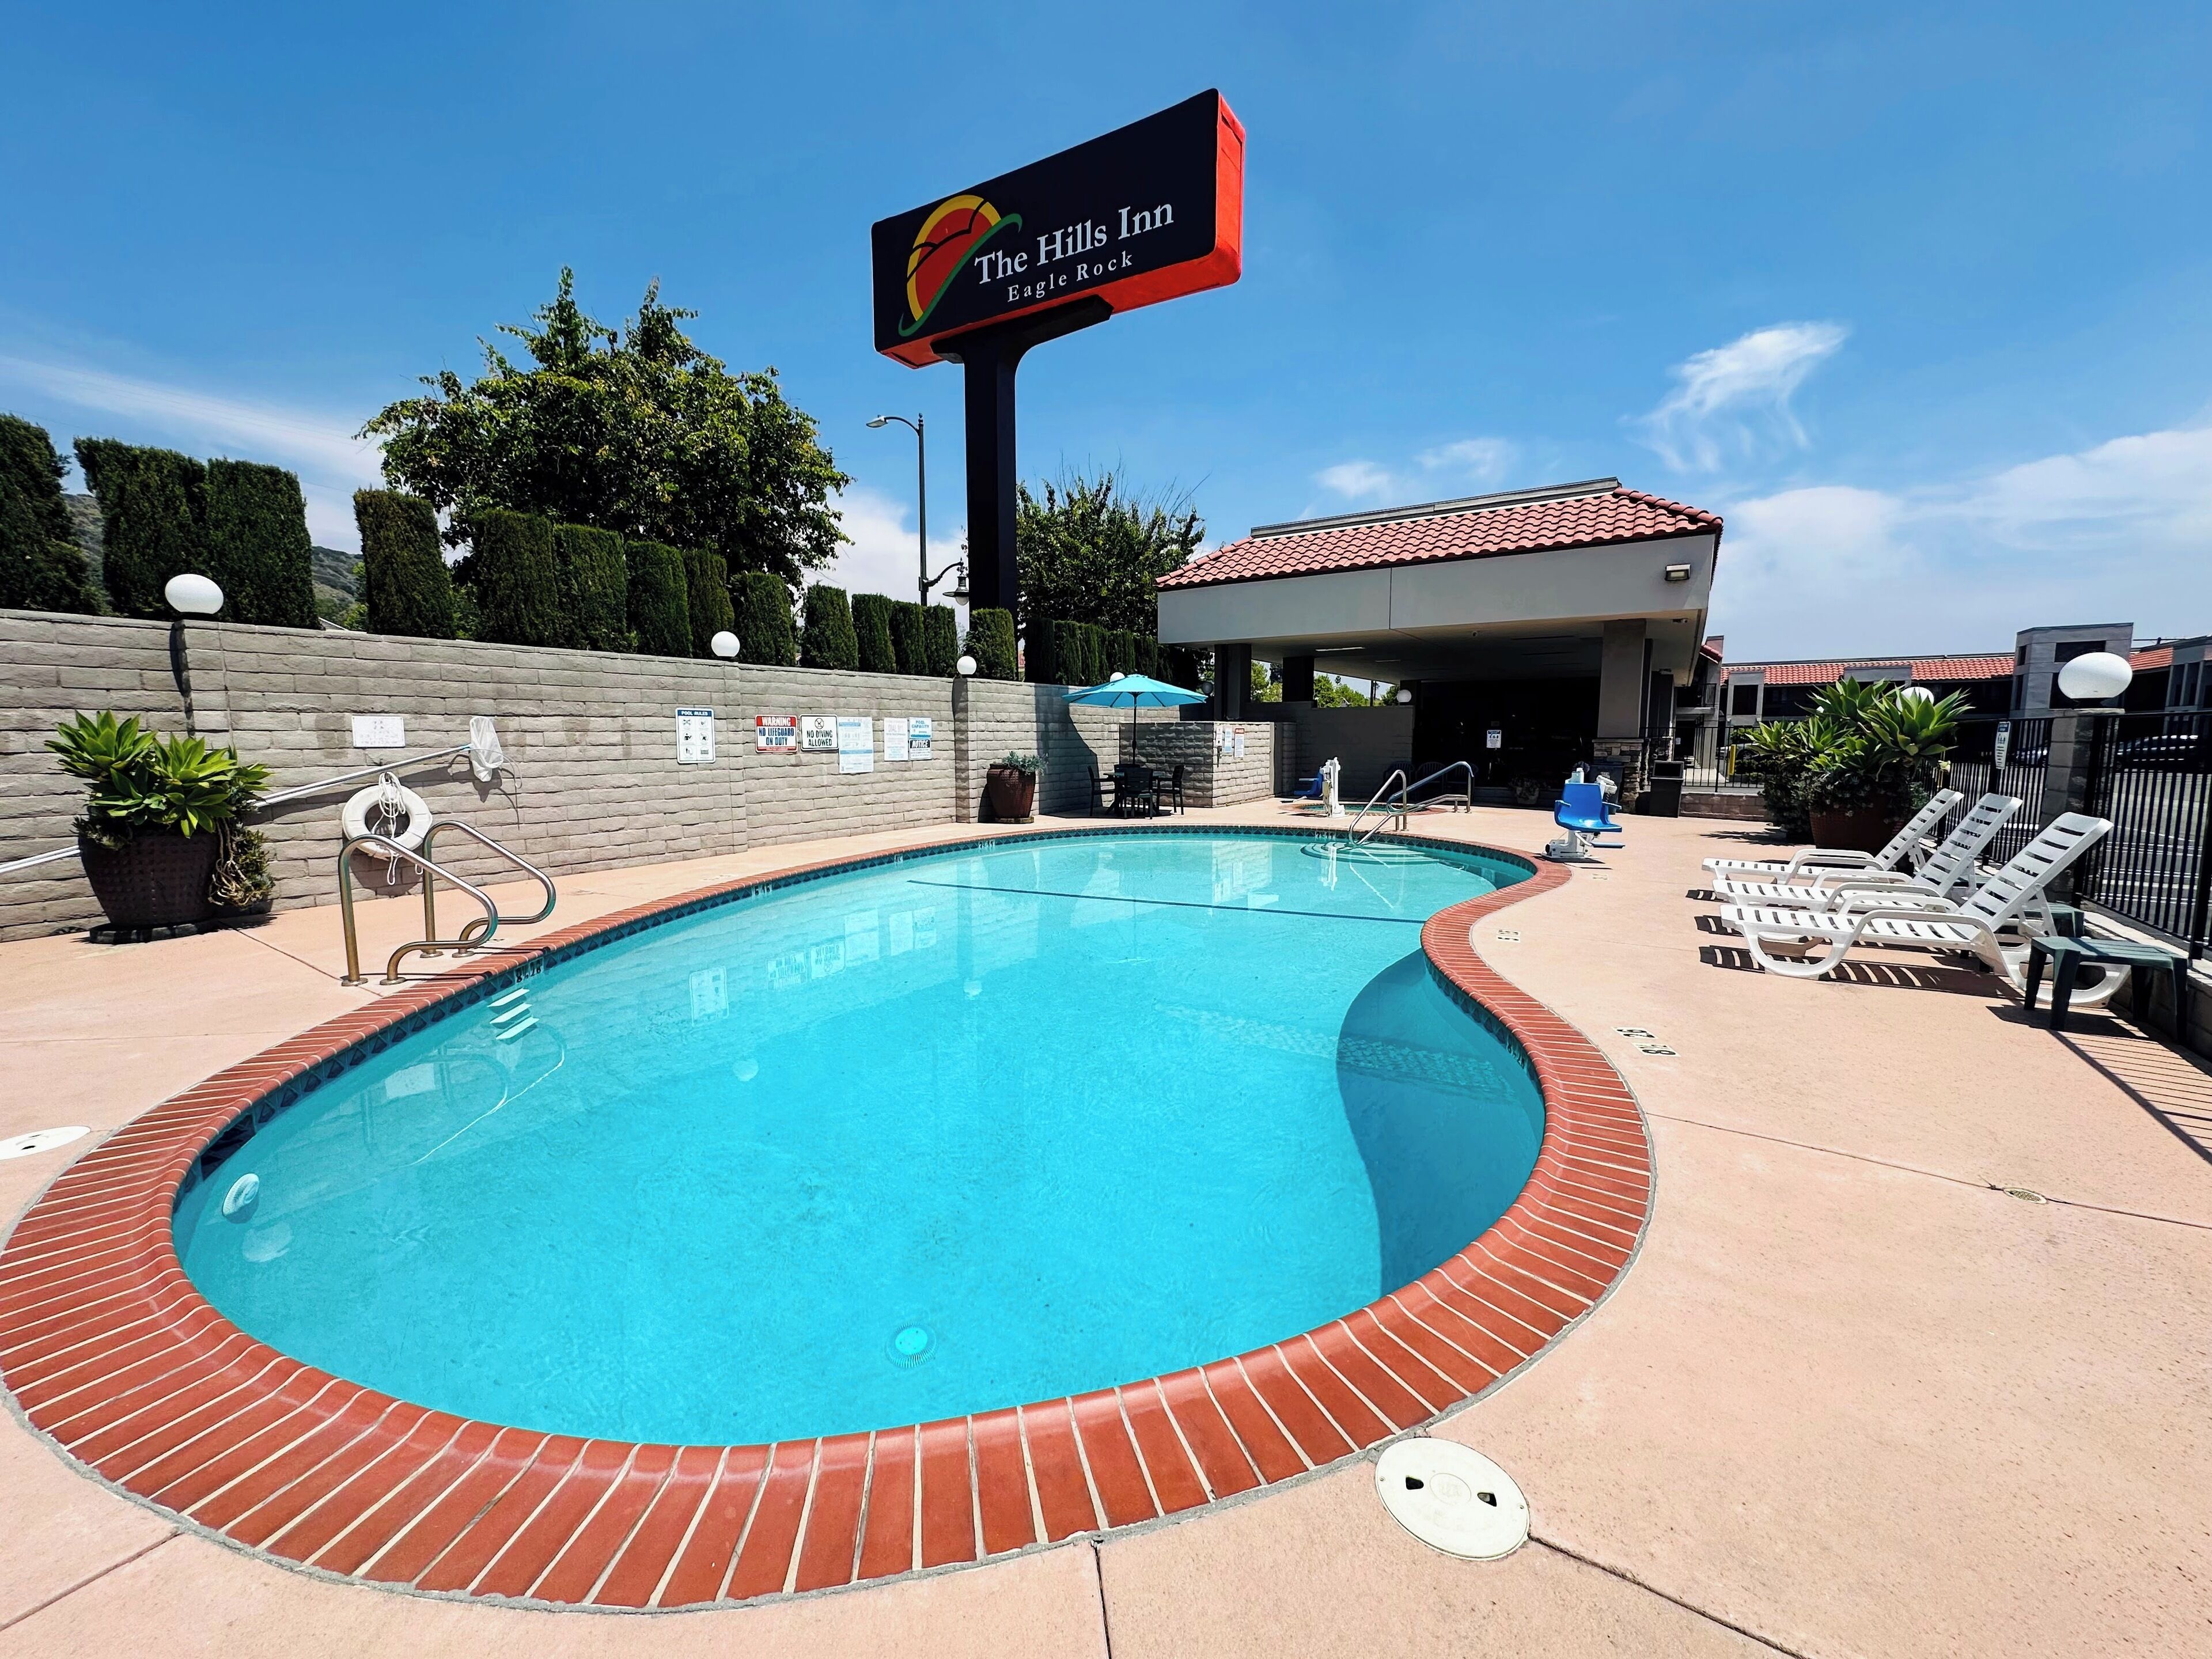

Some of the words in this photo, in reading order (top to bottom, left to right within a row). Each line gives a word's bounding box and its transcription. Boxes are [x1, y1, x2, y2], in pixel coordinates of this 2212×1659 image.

[974, 249, 1028, 284] The
[1037, 219, 1107, 266] Hills
[1118, 203, 1174, 240] Inn
[1007, 273, 1067, 302] Eagle
[1076, 251, 1132, 281] Rock
[762, 717, 791, 726] WARNING
[759, 727, 766, 736] NO
[768, 728, 794, 736] LIFEGUARD
[806, 730, 814, 738] NO
[816, 730, 833, 738] DIVING
[766, 737, 773, 745] ON
[775, 737, 787, 745] DUTY
[808, 738, 832, 747] ALLOWED
[911, 740, 929, 748] NOTICE
